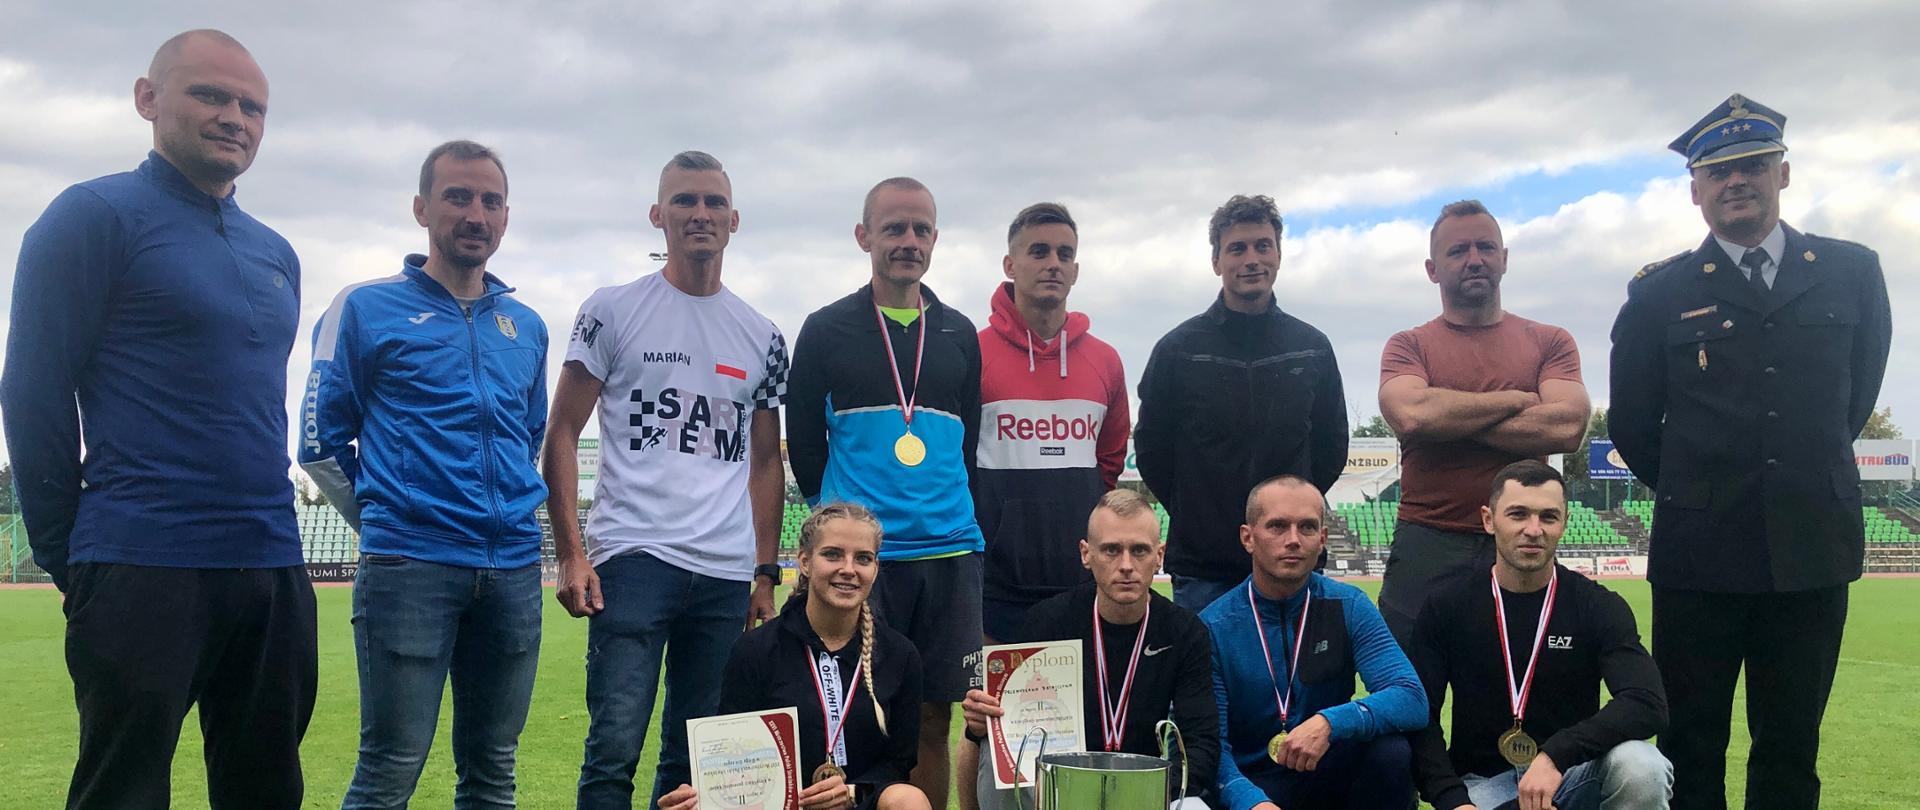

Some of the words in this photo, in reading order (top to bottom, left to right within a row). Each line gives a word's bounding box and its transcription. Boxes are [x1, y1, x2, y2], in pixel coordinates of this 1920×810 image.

[643, 351, 691, 366] MARIAN
[304, 370, 321, 455] Joma
[657, 387, 746, 432] START
[659, 420, 740, 462] TEAM
[996, 413, 1098, 441] Reebok
[1548, 635, 1573, 647] EA7
[963, 650, 983, 668] PHY
[1009, 651, 1074, 673] Dyplom
[821, 664, 840, 721] OFF-WHITE
